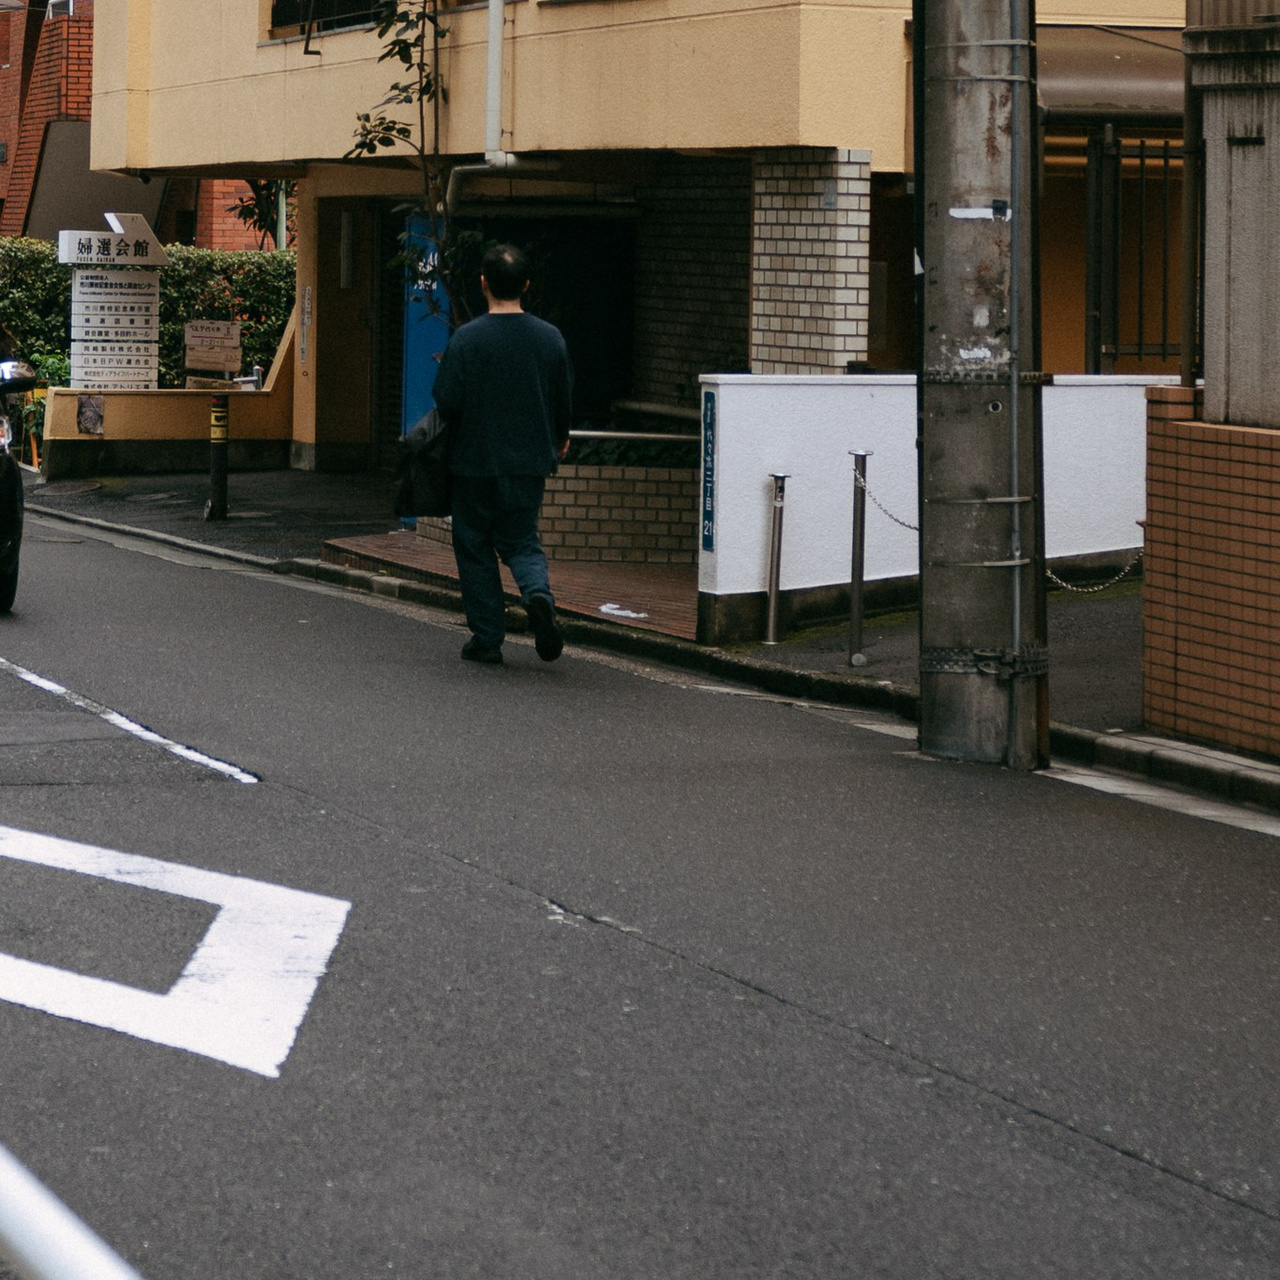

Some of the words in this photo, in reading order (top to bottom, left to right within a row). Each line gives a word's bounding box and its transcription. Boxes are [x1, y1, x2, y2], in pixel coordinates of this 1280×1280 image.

[77, 237, 150, 258] 婦選会館
[703, 520, 713, 536] 21
